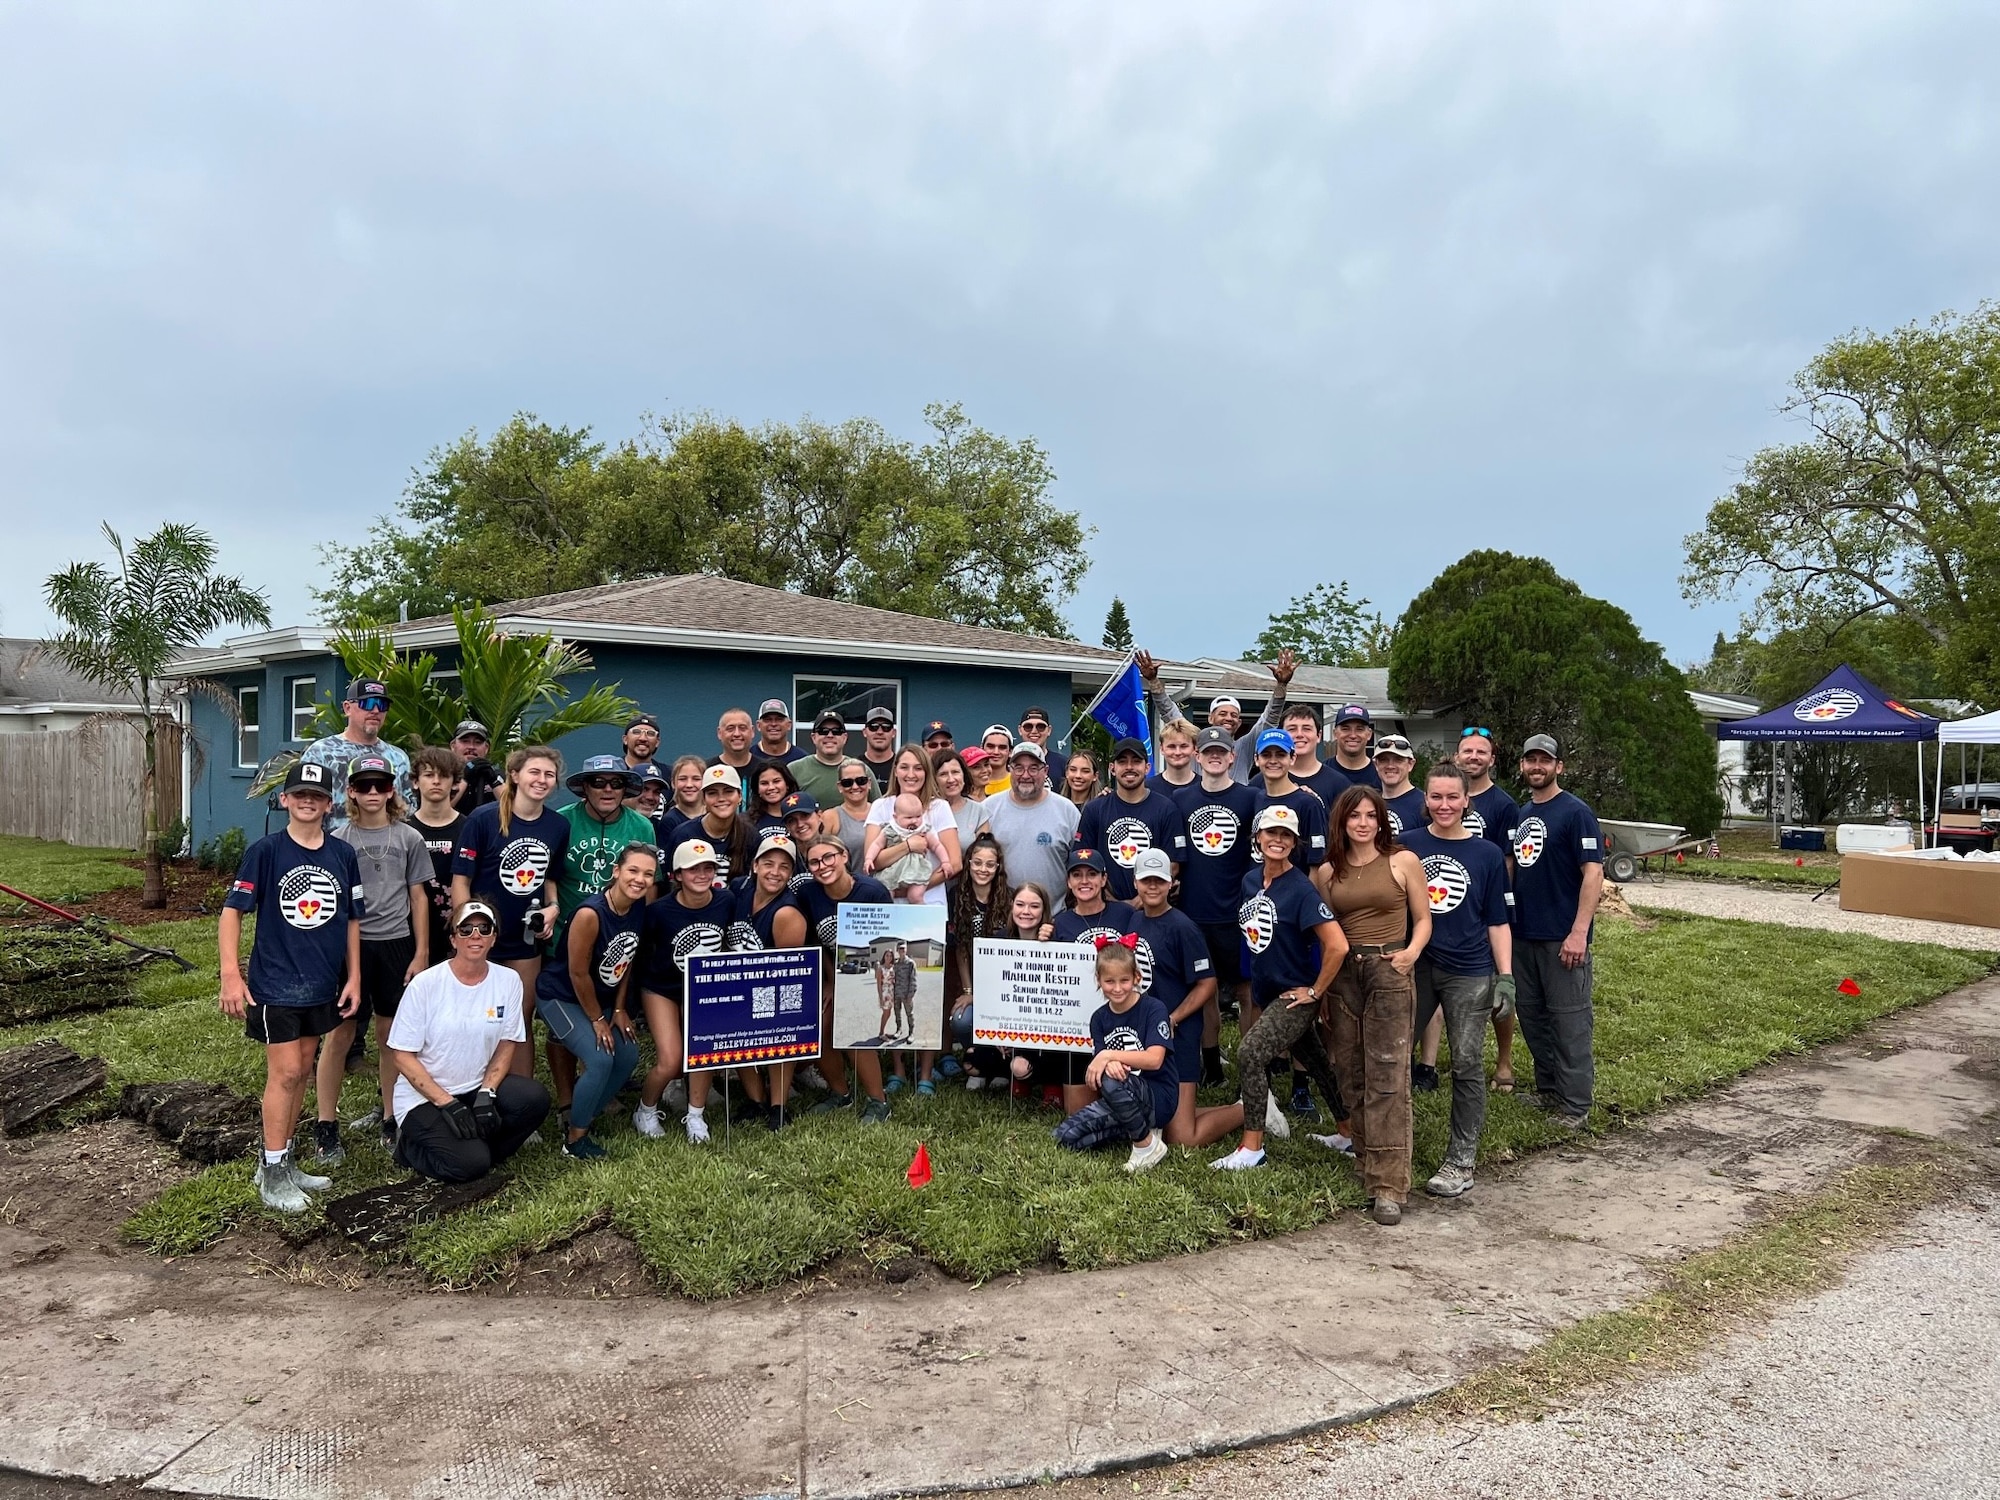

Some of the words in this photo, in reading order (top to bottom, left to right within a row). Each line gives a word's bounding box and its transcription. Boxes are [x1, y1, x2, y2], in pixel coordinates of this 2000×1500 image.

[1107, 712, 1127, 737] U.S.
[425, 840, 452, 848] OLLISTER
[321, 868, 334, 879] LOVE
[978, 947, 995, 955] THE
[998, 948, 1026, 957] HOUSE
[1029, 950, 1052, 959] THAT
[1055, 952, 1077, 960] LOVE
[1079, 953, 1096, 961] BUI
[1014, 962, 1022, 970] IN
[1026, 962, 1054, 972] HONOR
[1057, 964, 1068, 972] OF
[695, 975, 712, 983] THE
[714, 973, 741, 982] HOUSE
[743, 971, 764, 980] THAT
[766, 969, 788, 978] LOVE
[789, 968, 812, 976] BUILT
[1002, 970, 1041, 983] MAHLON
[1045, 972, 1080, 985] KESTER
[1001, 993, 1010, 1002] US
[754, 1028, 775, 1036] America's
[998, 1022, 1083, 1035] BELIEVEWITHME.COM
[713, 1034, 797, 1050] BELIEVEWITHME.COM
